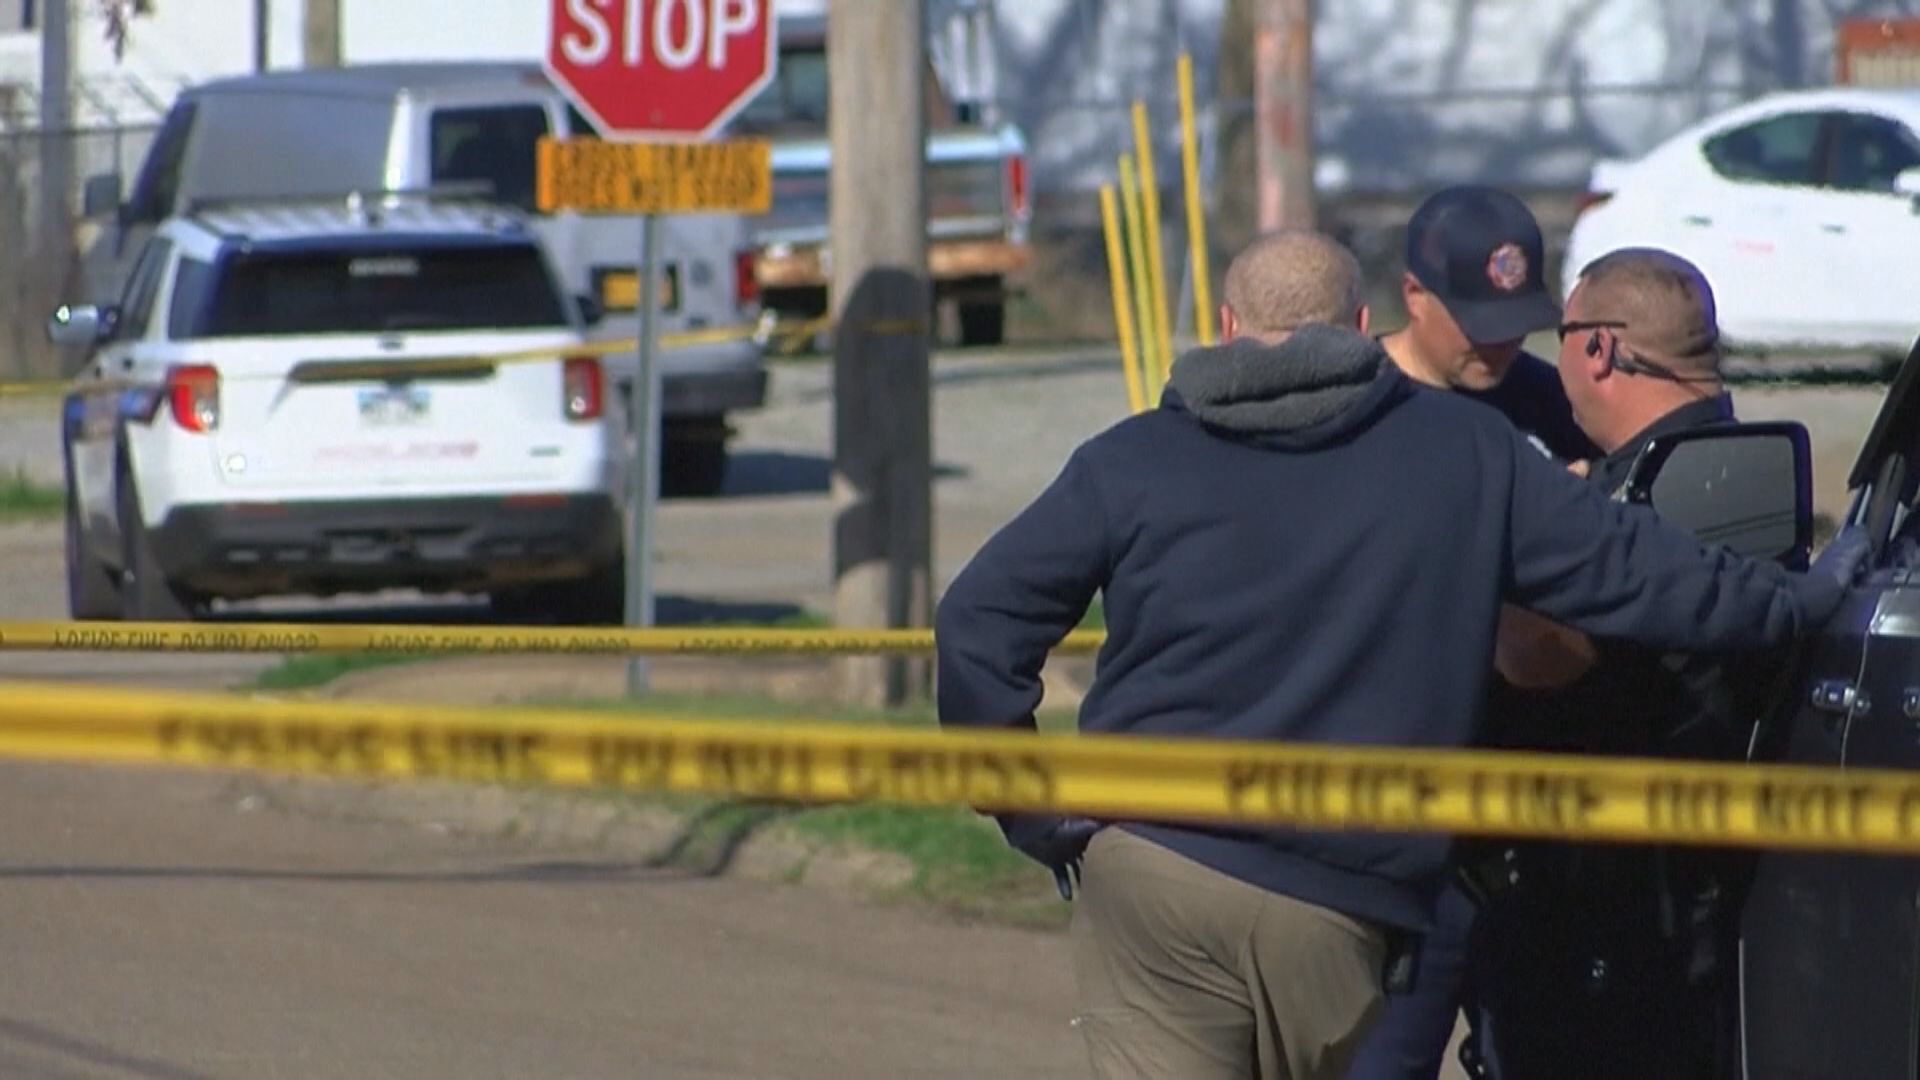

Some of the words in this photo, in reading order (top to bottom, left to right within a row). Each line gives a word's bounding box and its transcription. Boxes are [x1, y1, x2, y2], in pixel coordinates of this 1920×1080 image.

[560, 0, 757, 69] STOP
[1225, 760, 1440, 825] POLICE
[1469, 768, 1605, 834] LINE
[1644, 776, 1730, 836] DO
[1757, 780, 1874, 843] NOT
